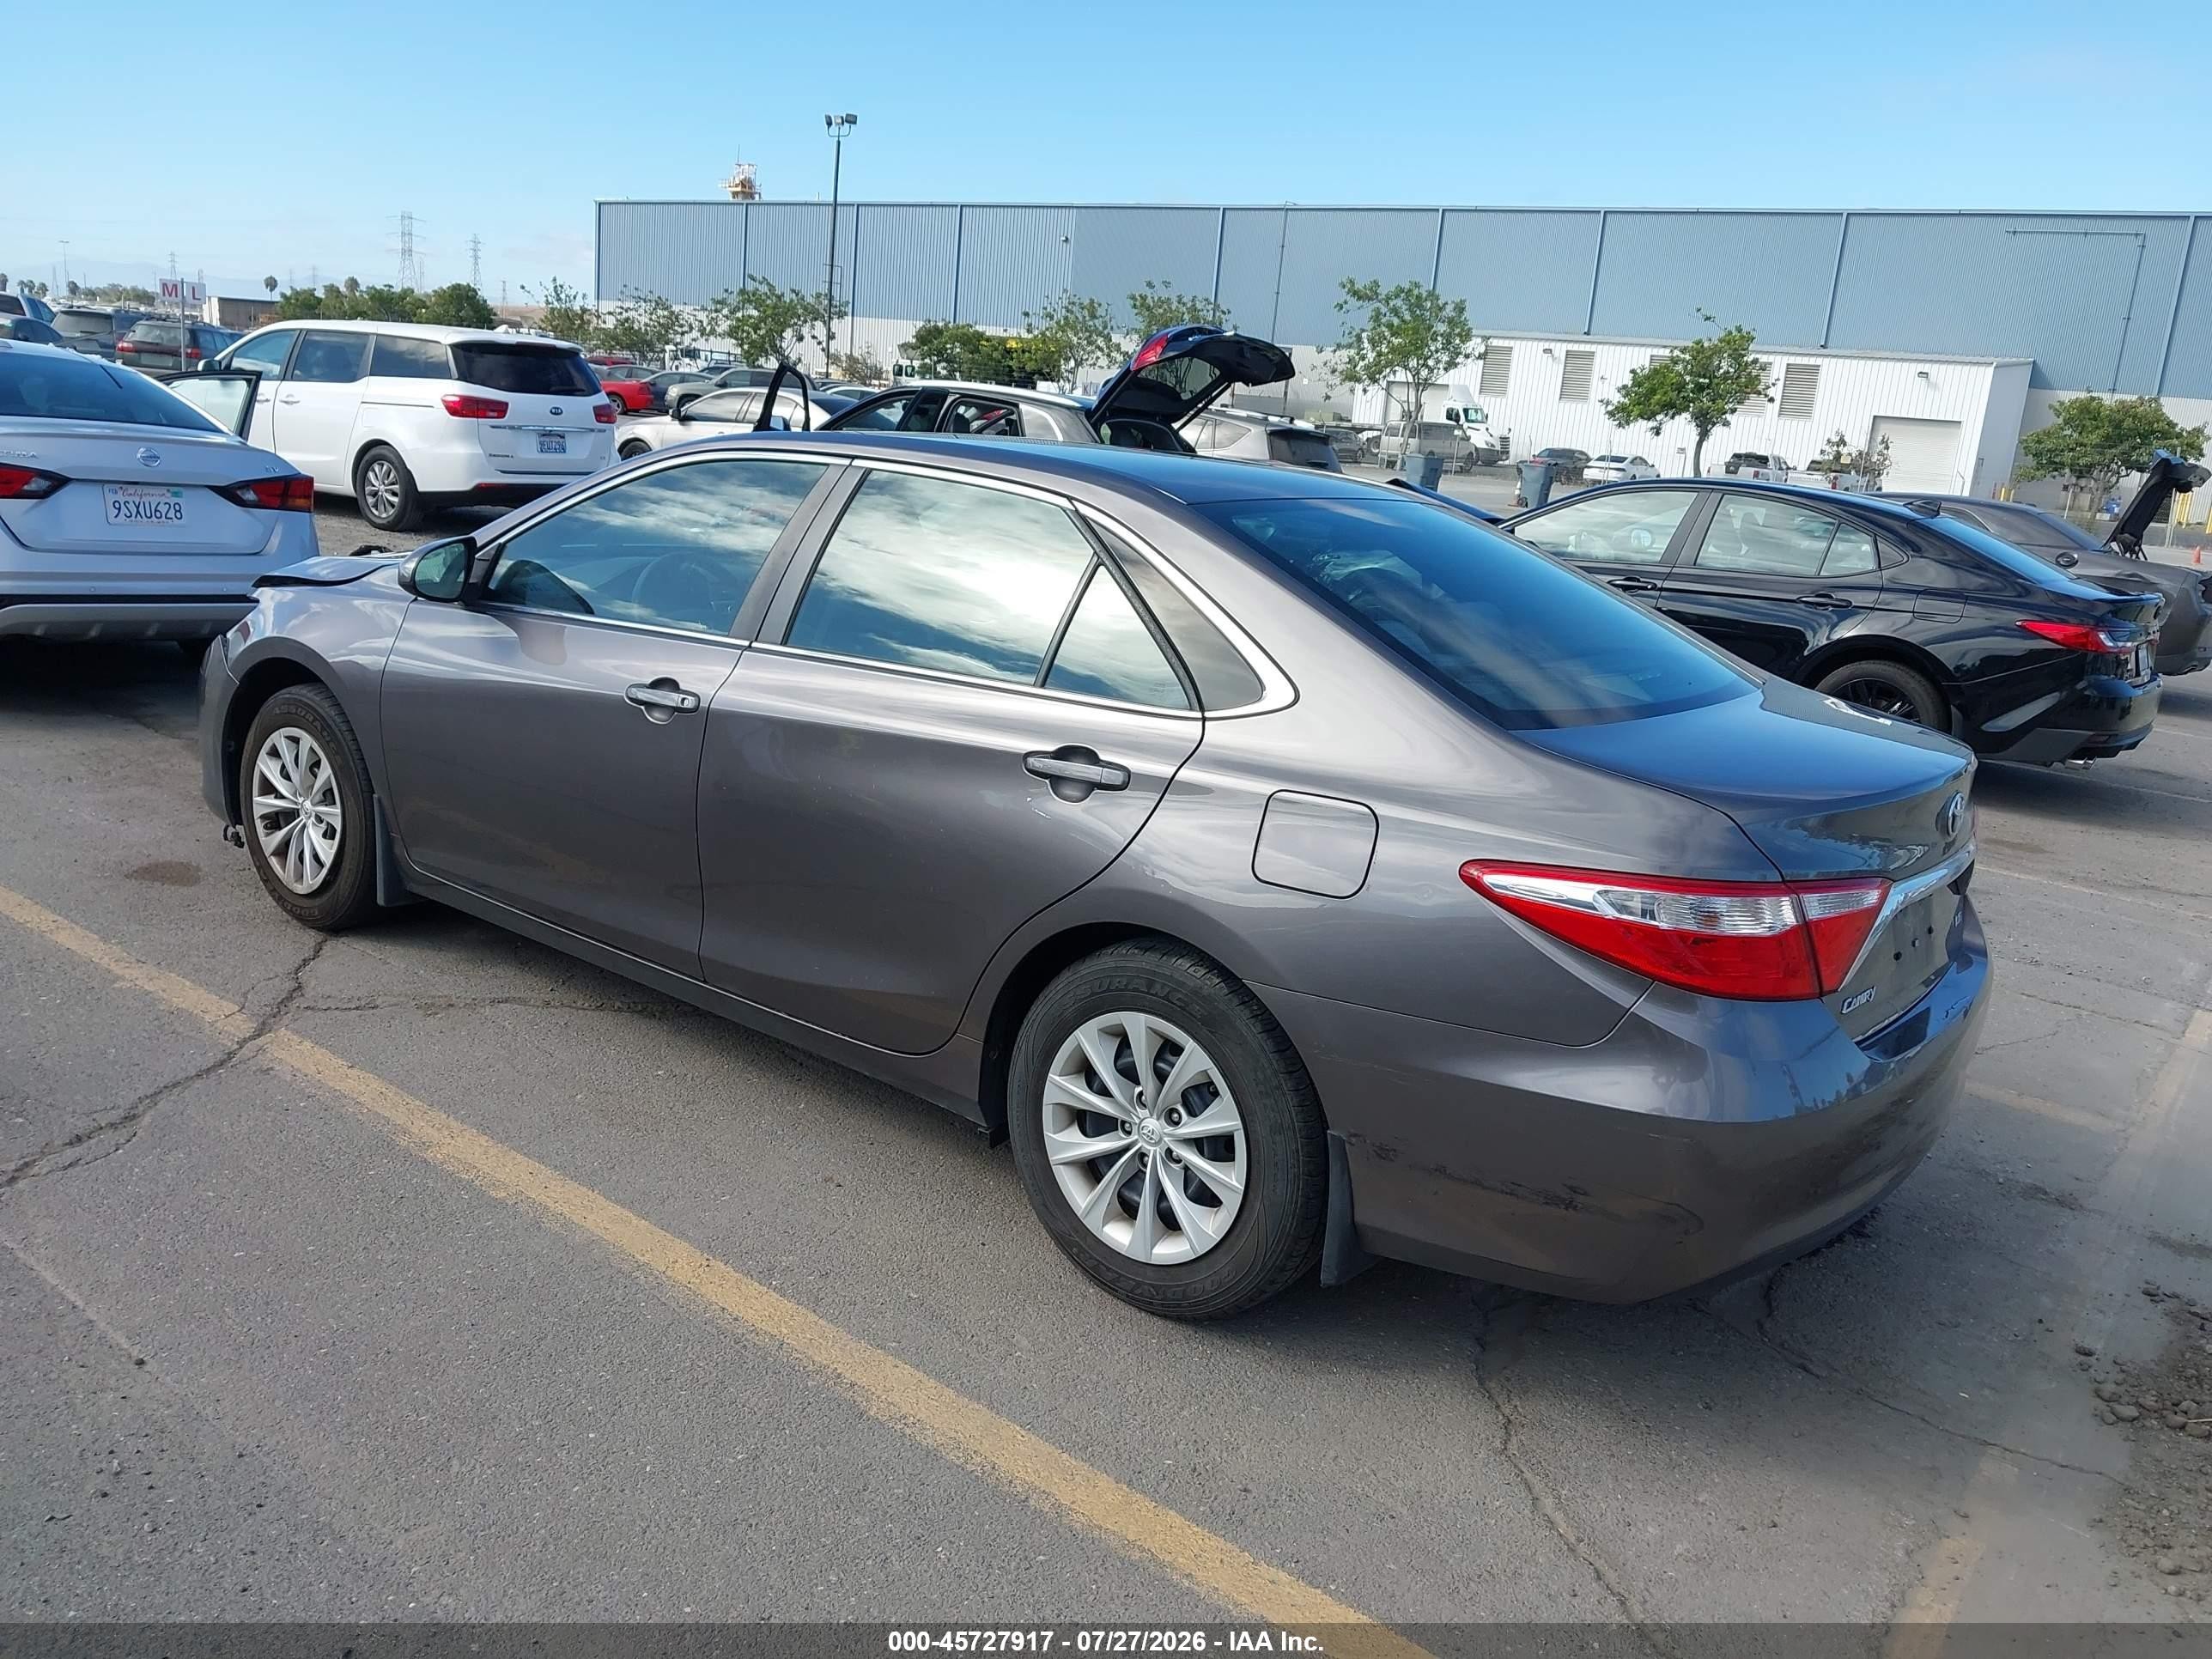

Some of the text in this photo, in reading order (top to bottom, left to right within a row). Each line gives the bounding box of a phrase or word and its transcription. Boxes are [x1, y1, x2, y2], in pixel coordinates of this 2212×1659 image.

[162, 283, 178, 298] M
[192, 286, 201, 301] L
[121, 487, 167, 501] California
[112, 500, 183, 520] 9SXU628
[1840, 986, 1876, 1014] CAMRY
